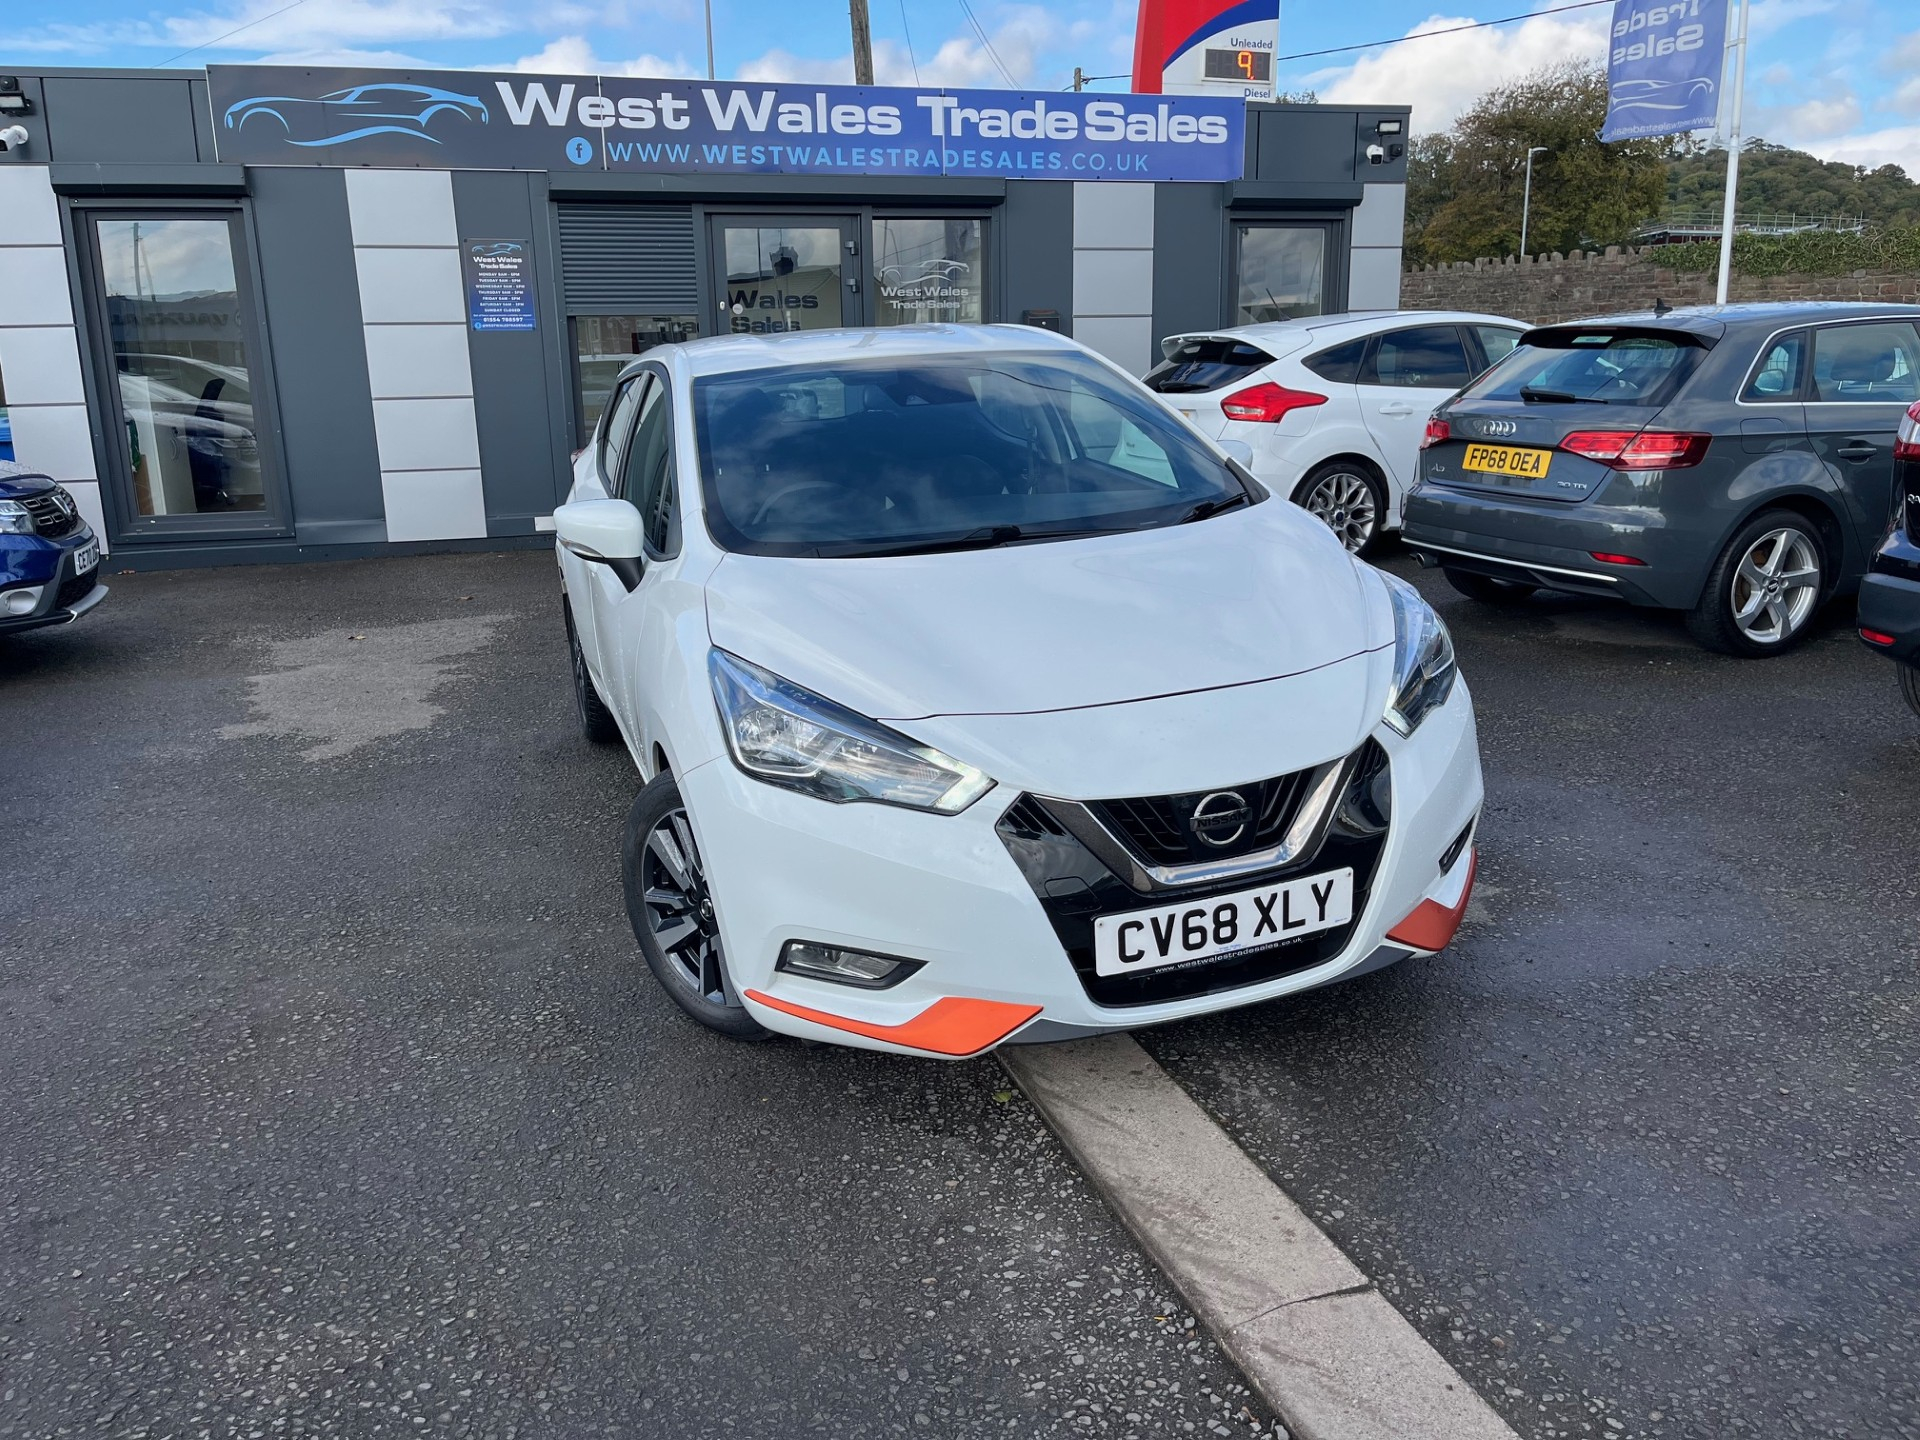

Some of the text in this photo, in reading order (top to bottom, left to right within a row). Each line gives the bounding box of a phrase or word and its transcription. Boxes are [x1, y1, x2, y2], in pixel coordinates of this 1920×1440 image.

[1230, 37, 1273, 49] Unleaded
[1244, 88, 1271, 98] Diesel
[494, 81, 1228, 144] West Wales Trade Sales
[607, 142, 1149, 172] WWW.WESTWALESTRADESALES.CO.UK
[728, 289, 819, 310] Wales
[880, 286, 969, 297] West Wales
[890, 300, 960, 309] Trade Sales
[731, 316, 801, 334] Sales
[1468, 447, 1541, 474] FP68 OEA
[1198, 812, 1247, 828] NISSAN
[1117, 879, 1335, 964] CV68 XLY
[1154, 937, 1302, 974] www.westwalestradesales.co.uk
